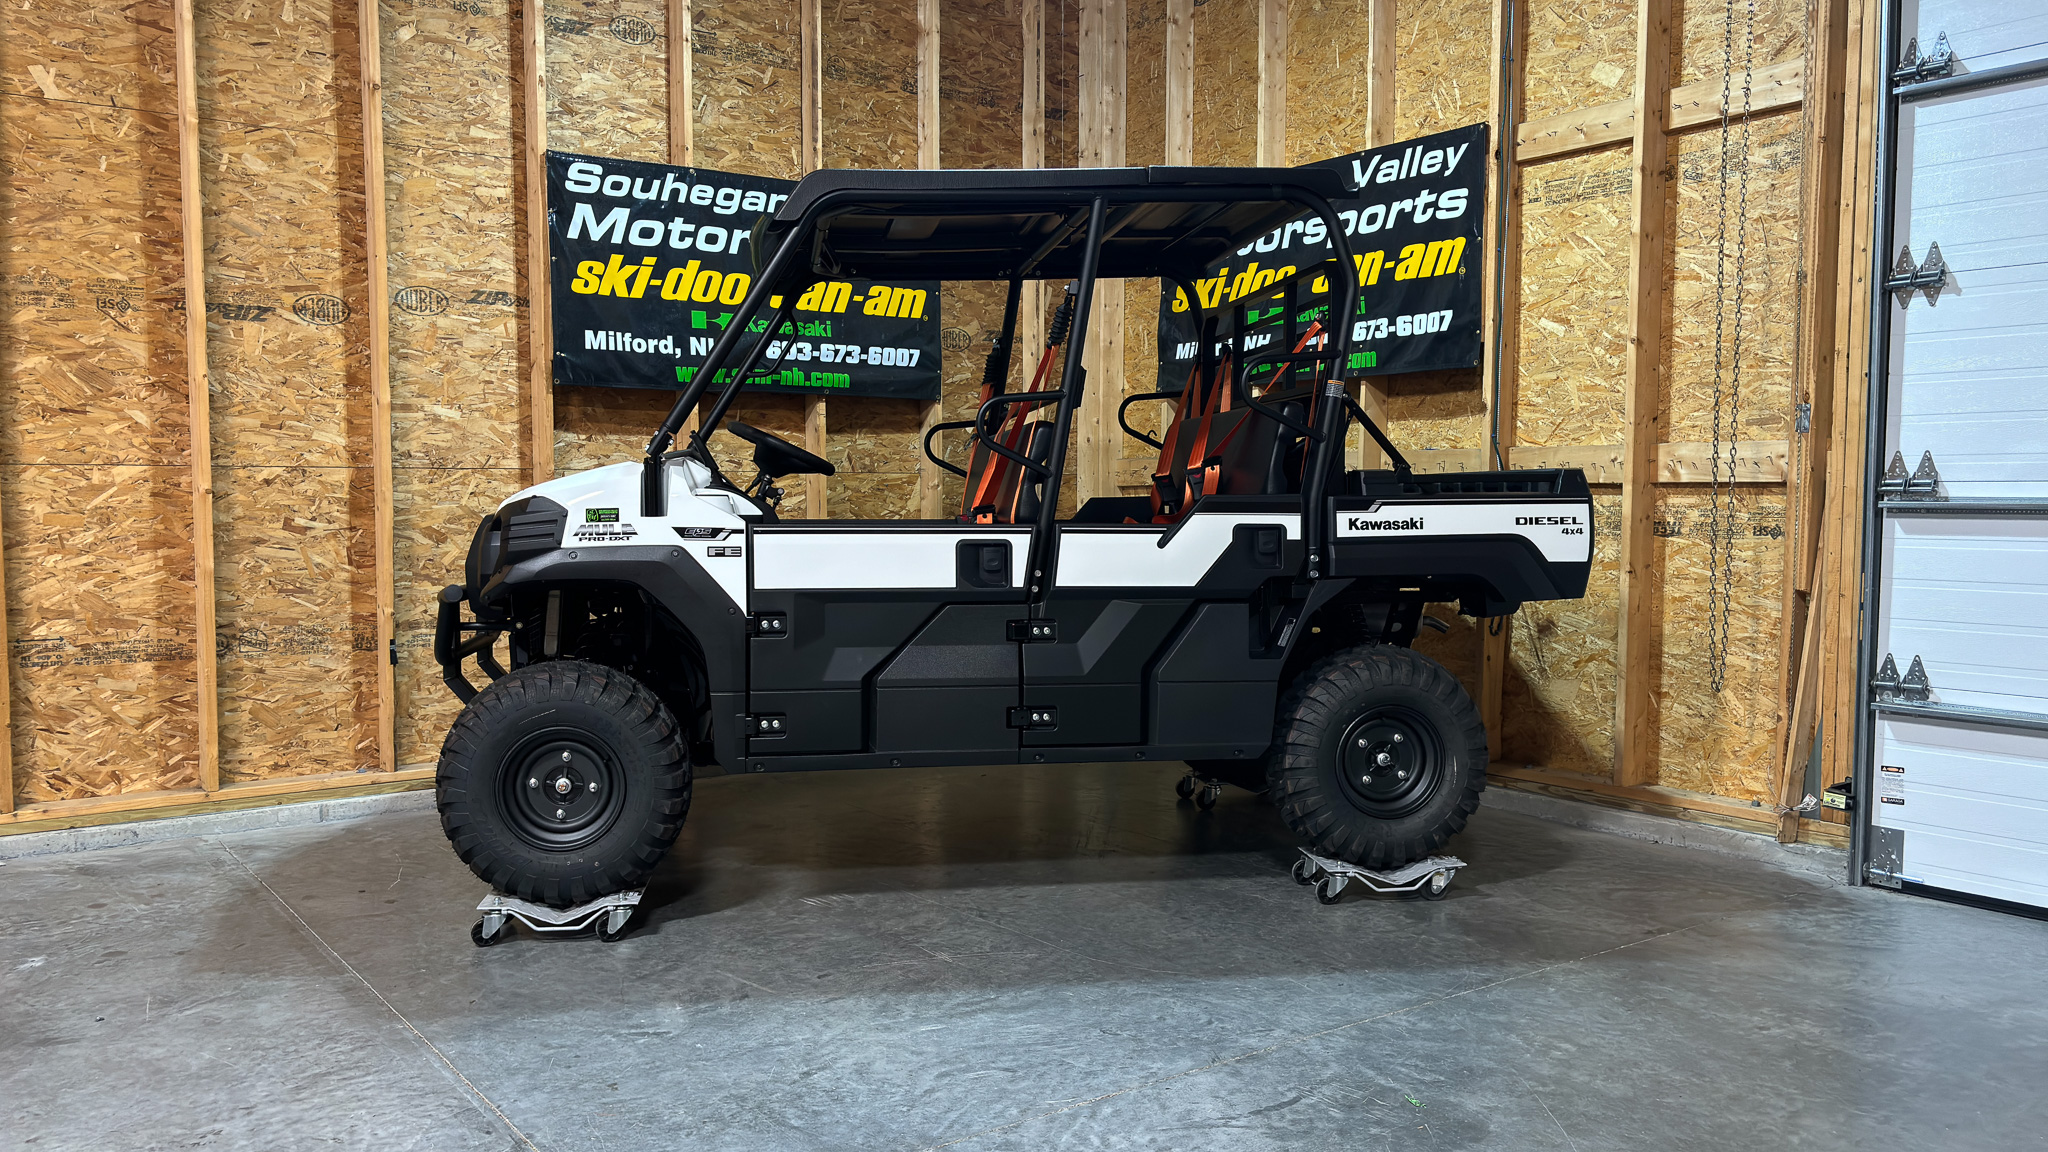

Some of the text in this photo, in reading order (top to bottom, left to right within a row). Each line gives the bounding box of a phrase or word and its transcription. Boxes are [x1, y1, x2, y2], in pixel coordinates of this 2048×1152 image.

[1351, 143, 1469, 188] Valley
[571, 254, 752, 305] ski-doo
[584, 329, 682, 359] Milford,
[765, 340, 921, 367] 603-673-6007
[1348, 517, 1424, 531] Kawasaki
[1515, 516, 1584, 525] DIESEL
[573, 523, 639, 537] MULE
[1561, 527, 1584, 536] 4x4
[708, 547, 741, 556] FE
